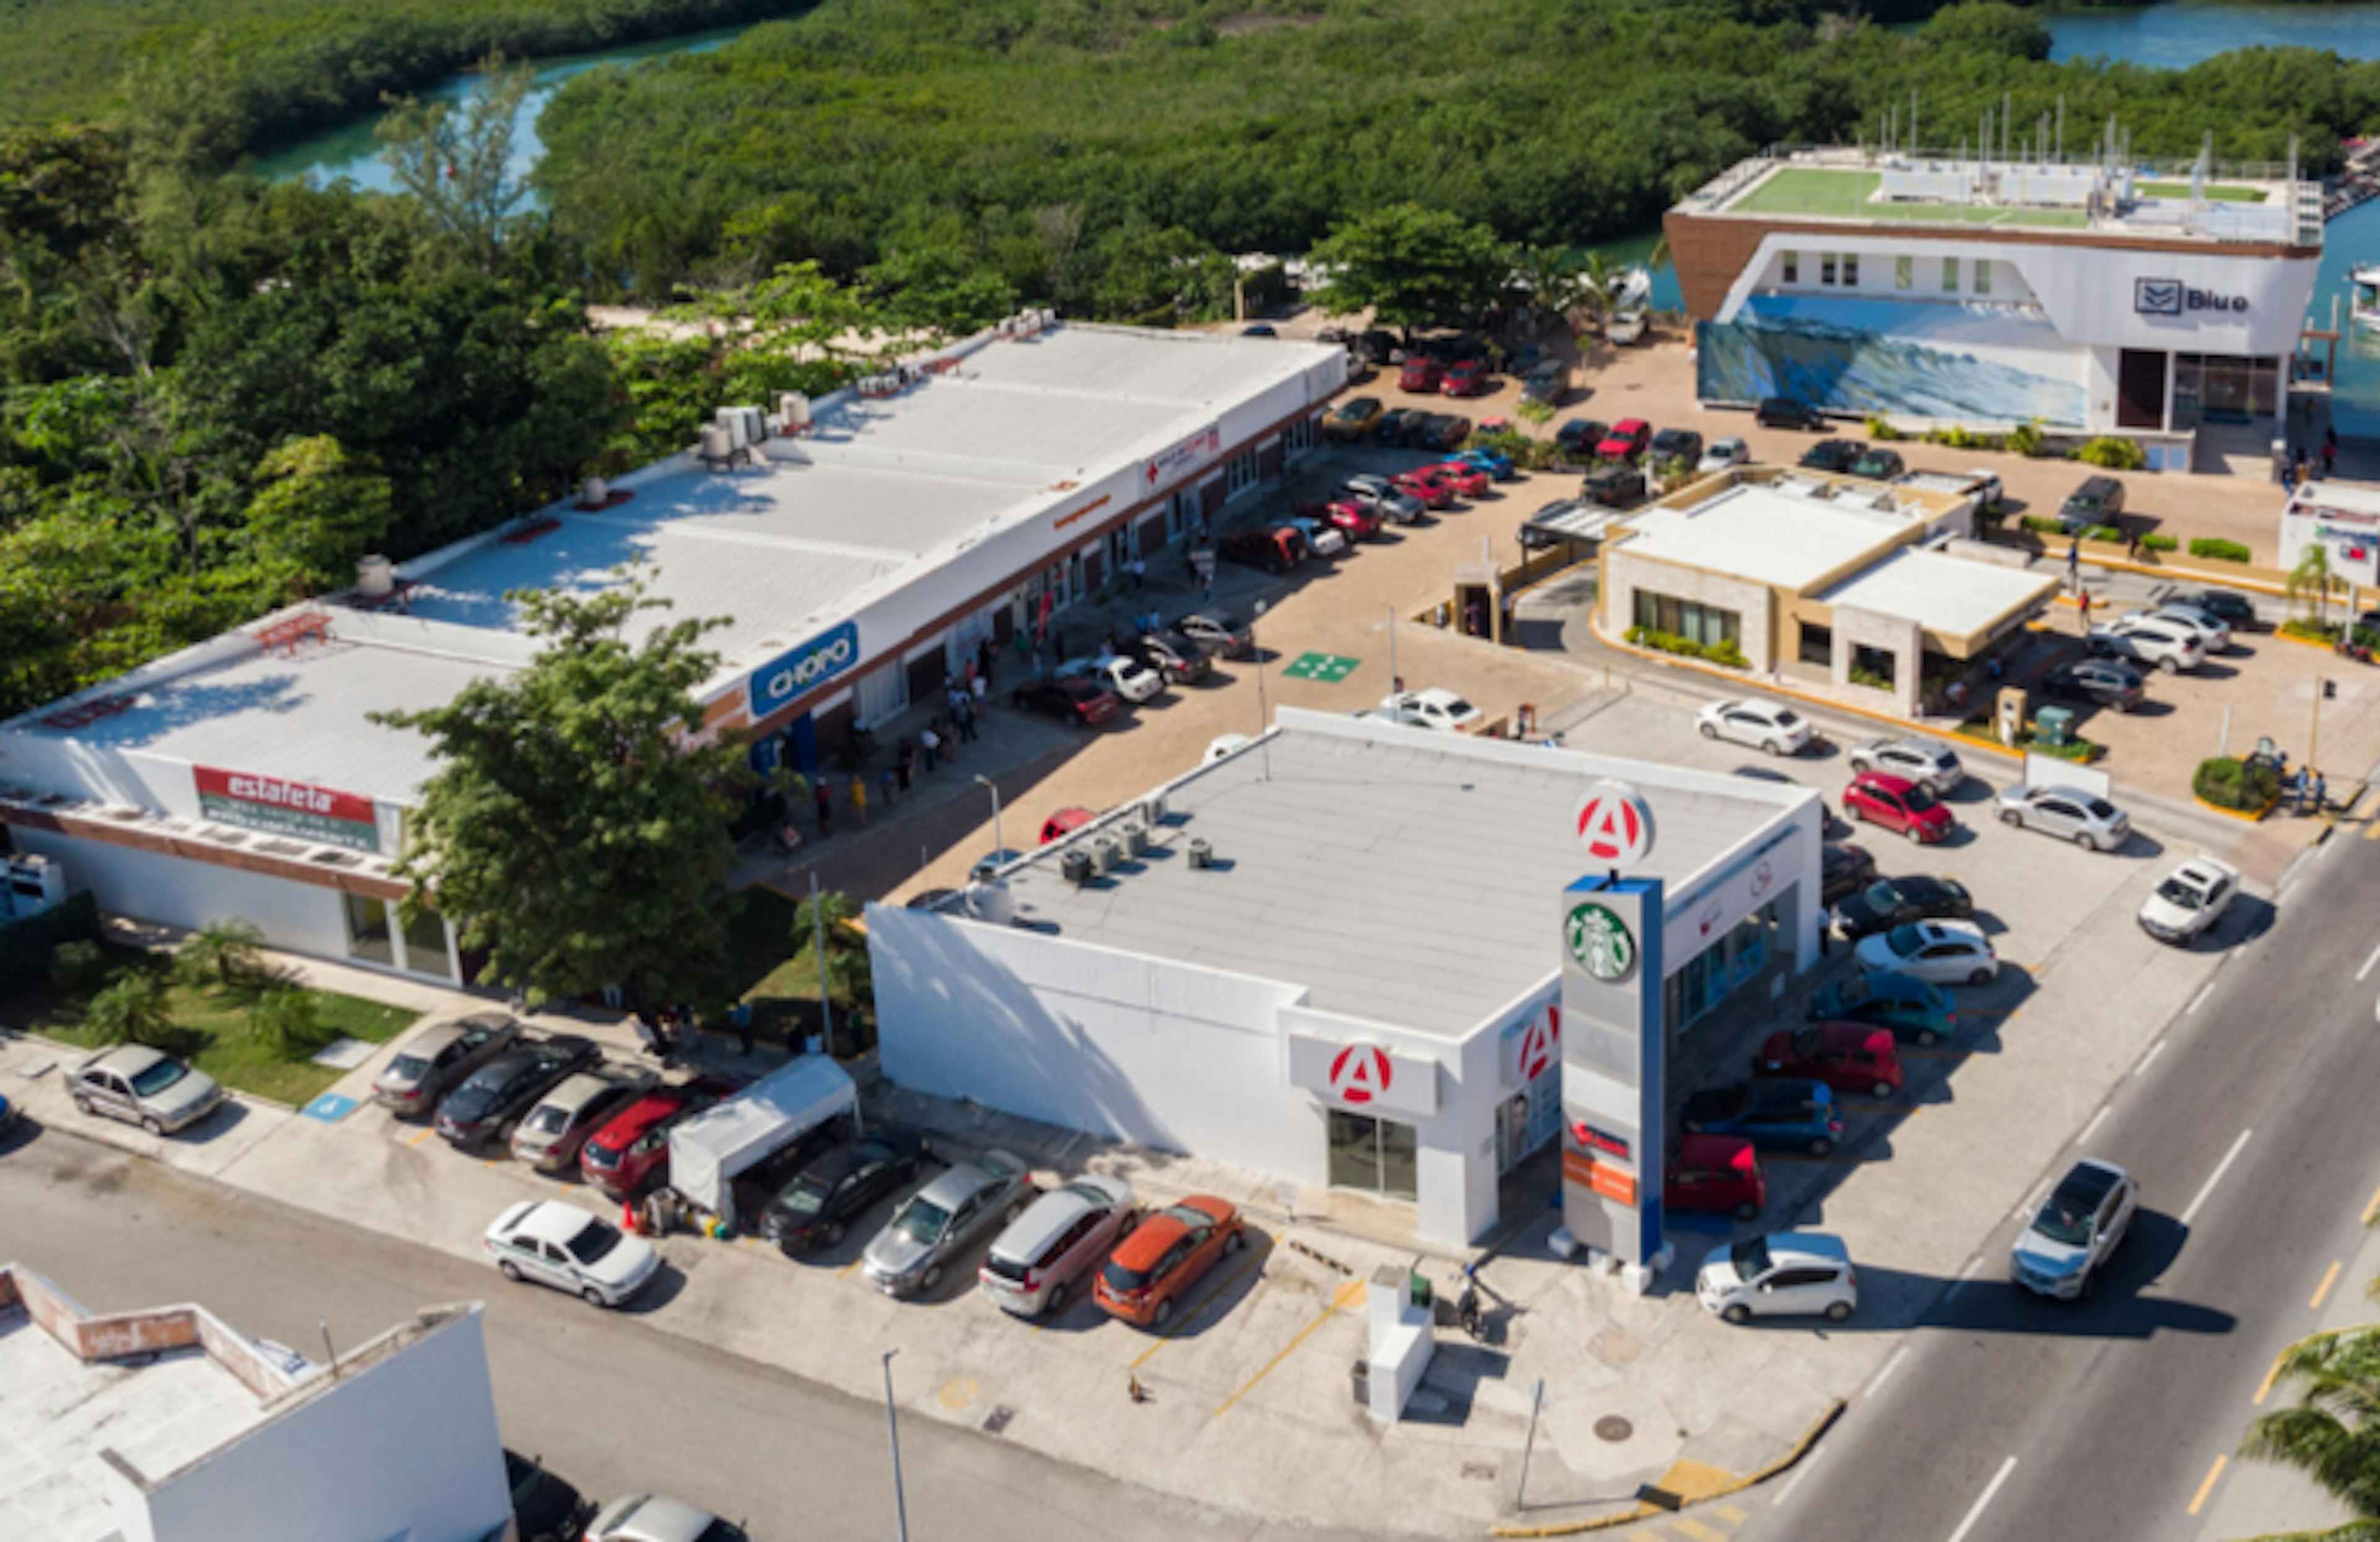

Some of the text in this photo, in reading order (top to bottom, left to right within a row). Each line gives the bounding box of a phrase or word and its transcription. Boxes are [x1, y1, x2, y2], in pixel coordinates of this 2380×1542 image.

[2187, 289, 2248, 312] Blue
[769, 638, 850, 698] CHOPO
[229, 776, 332, 812] estafeta
[1577, 795, 1639, 859] A
[1329, 1044, 1393, 1104] A
